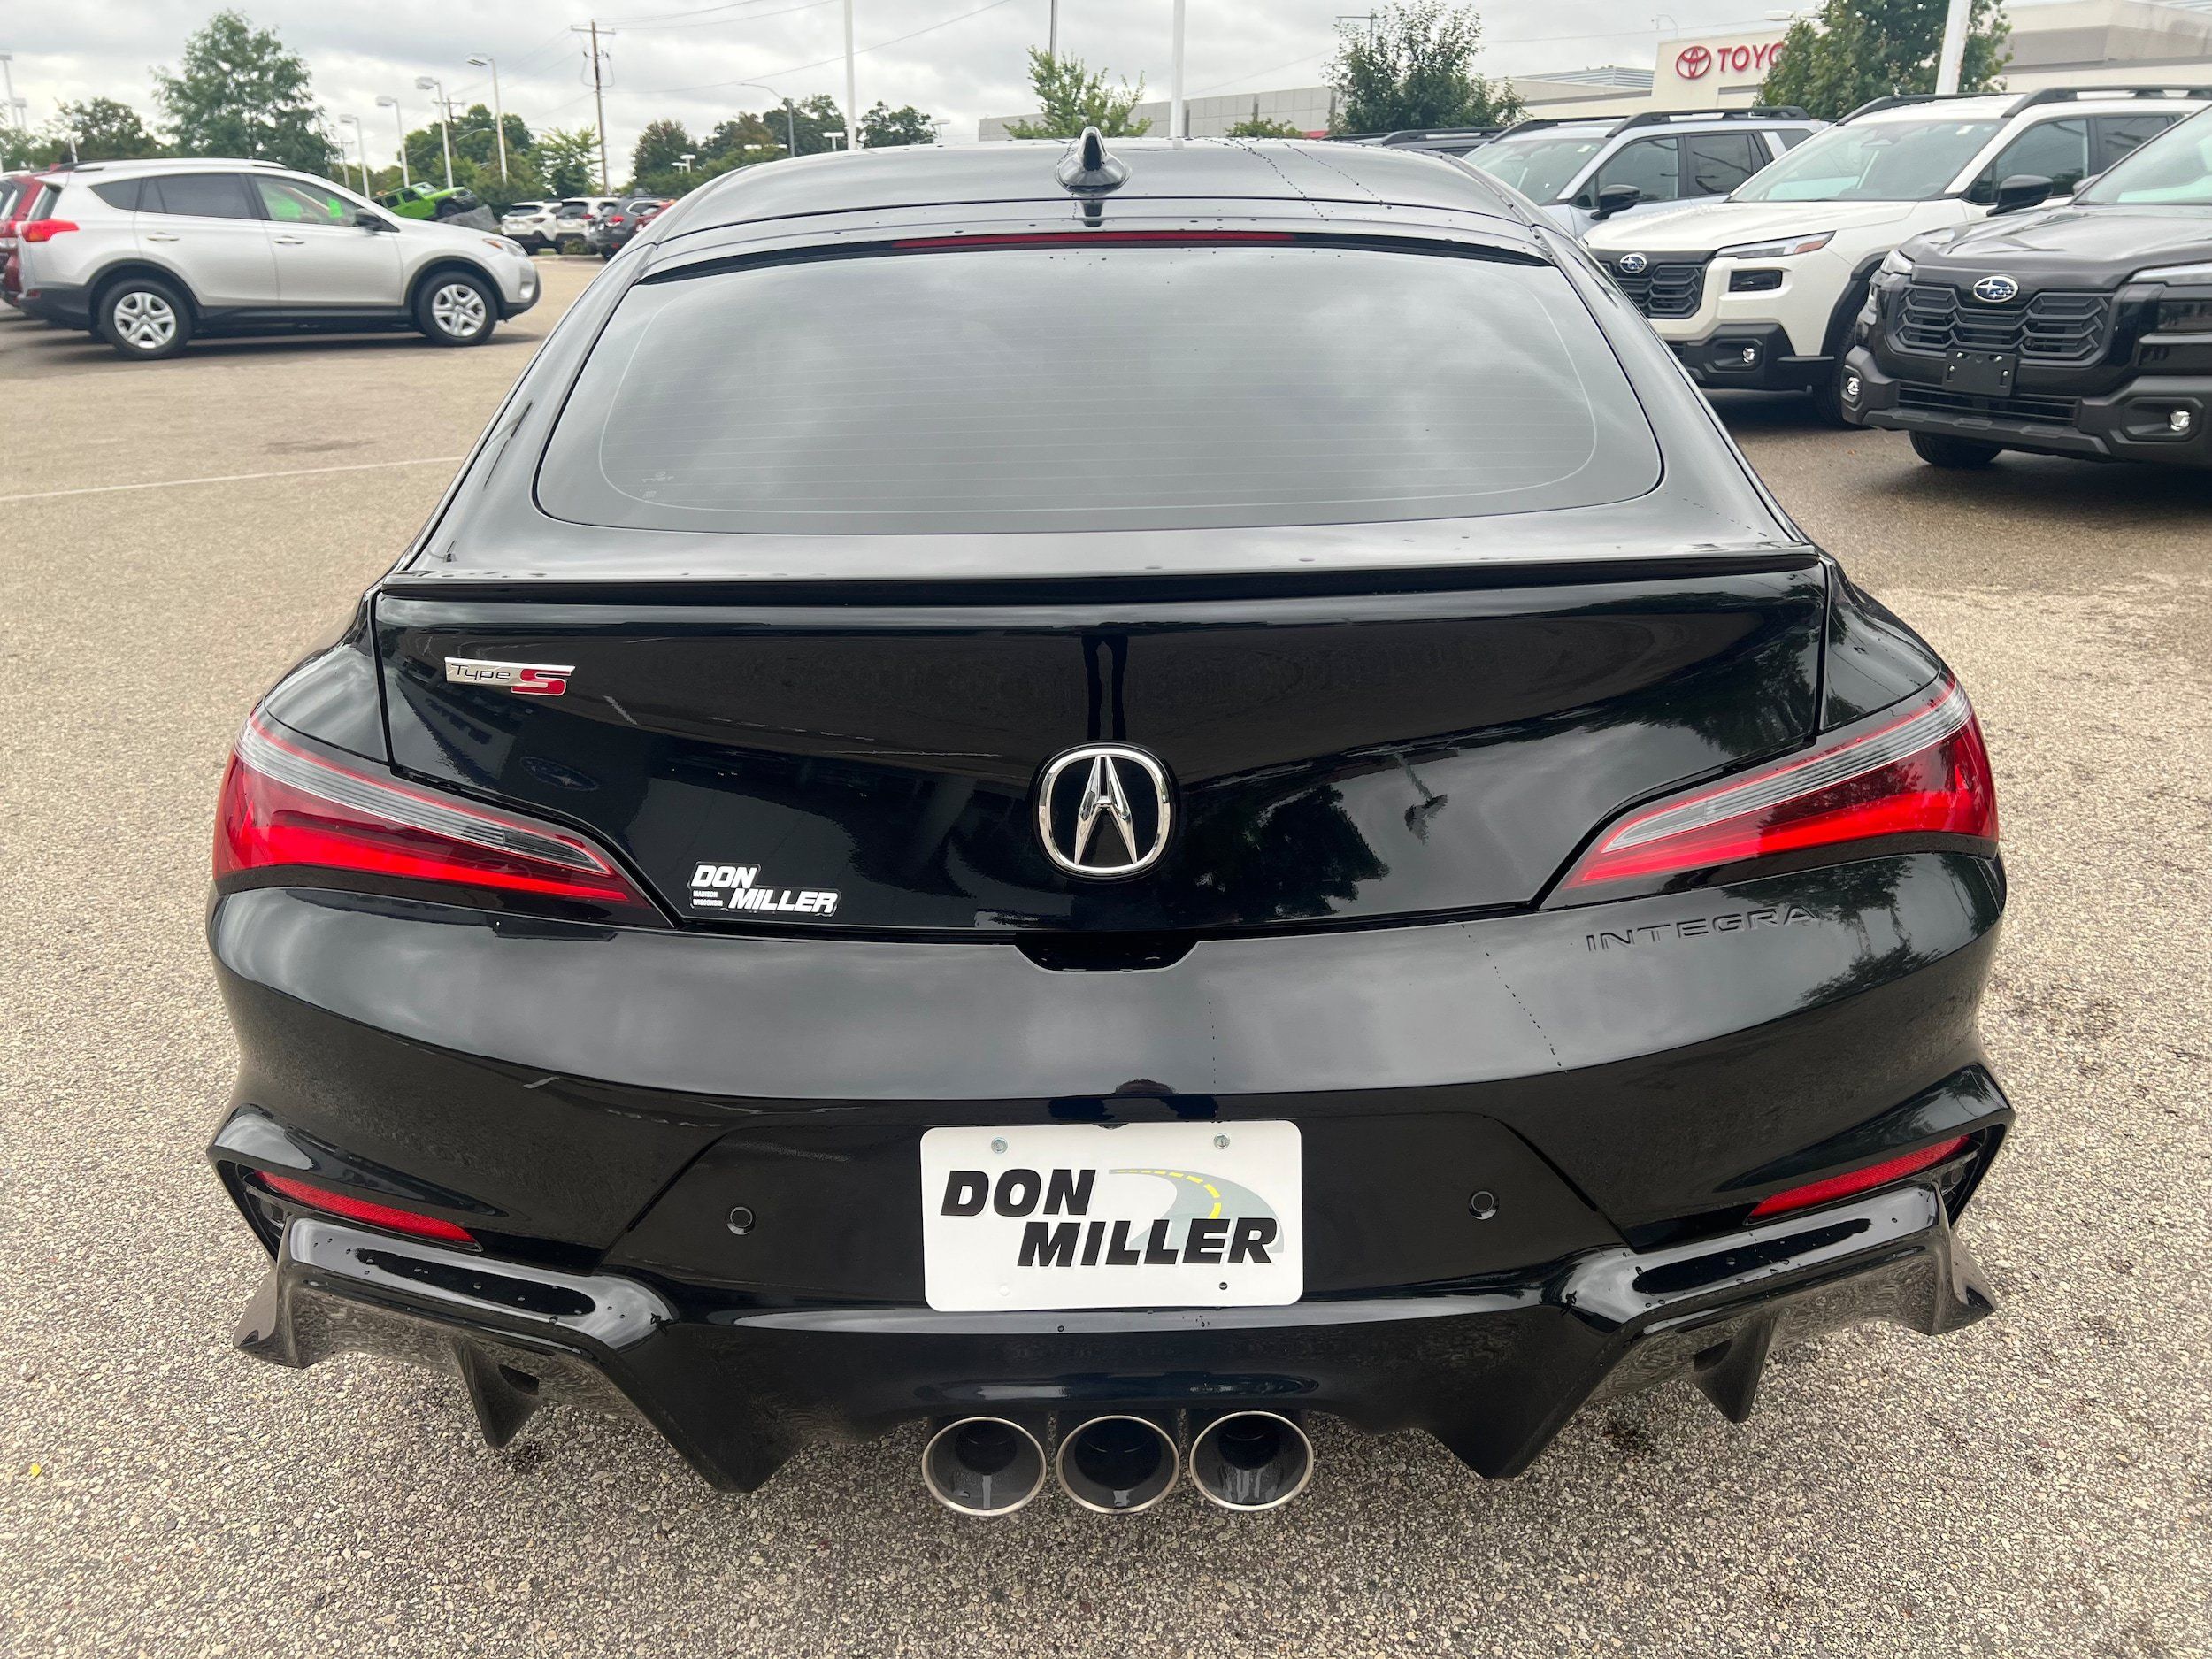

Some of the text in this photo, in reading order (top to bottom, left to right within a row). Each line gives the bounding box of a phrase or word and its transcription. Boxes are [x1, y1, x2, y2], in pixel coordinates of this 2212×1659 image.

[450, 664, 572, 696] Type S
[691, 864, 758, 889] DON
[728, 887, 839, 913] MILLER
[1586, 904, 1818, 952] INTEGRA
[940, 1168, 1098, 1217] DON
[1016, 1217, 1278, 1268] MILLER
